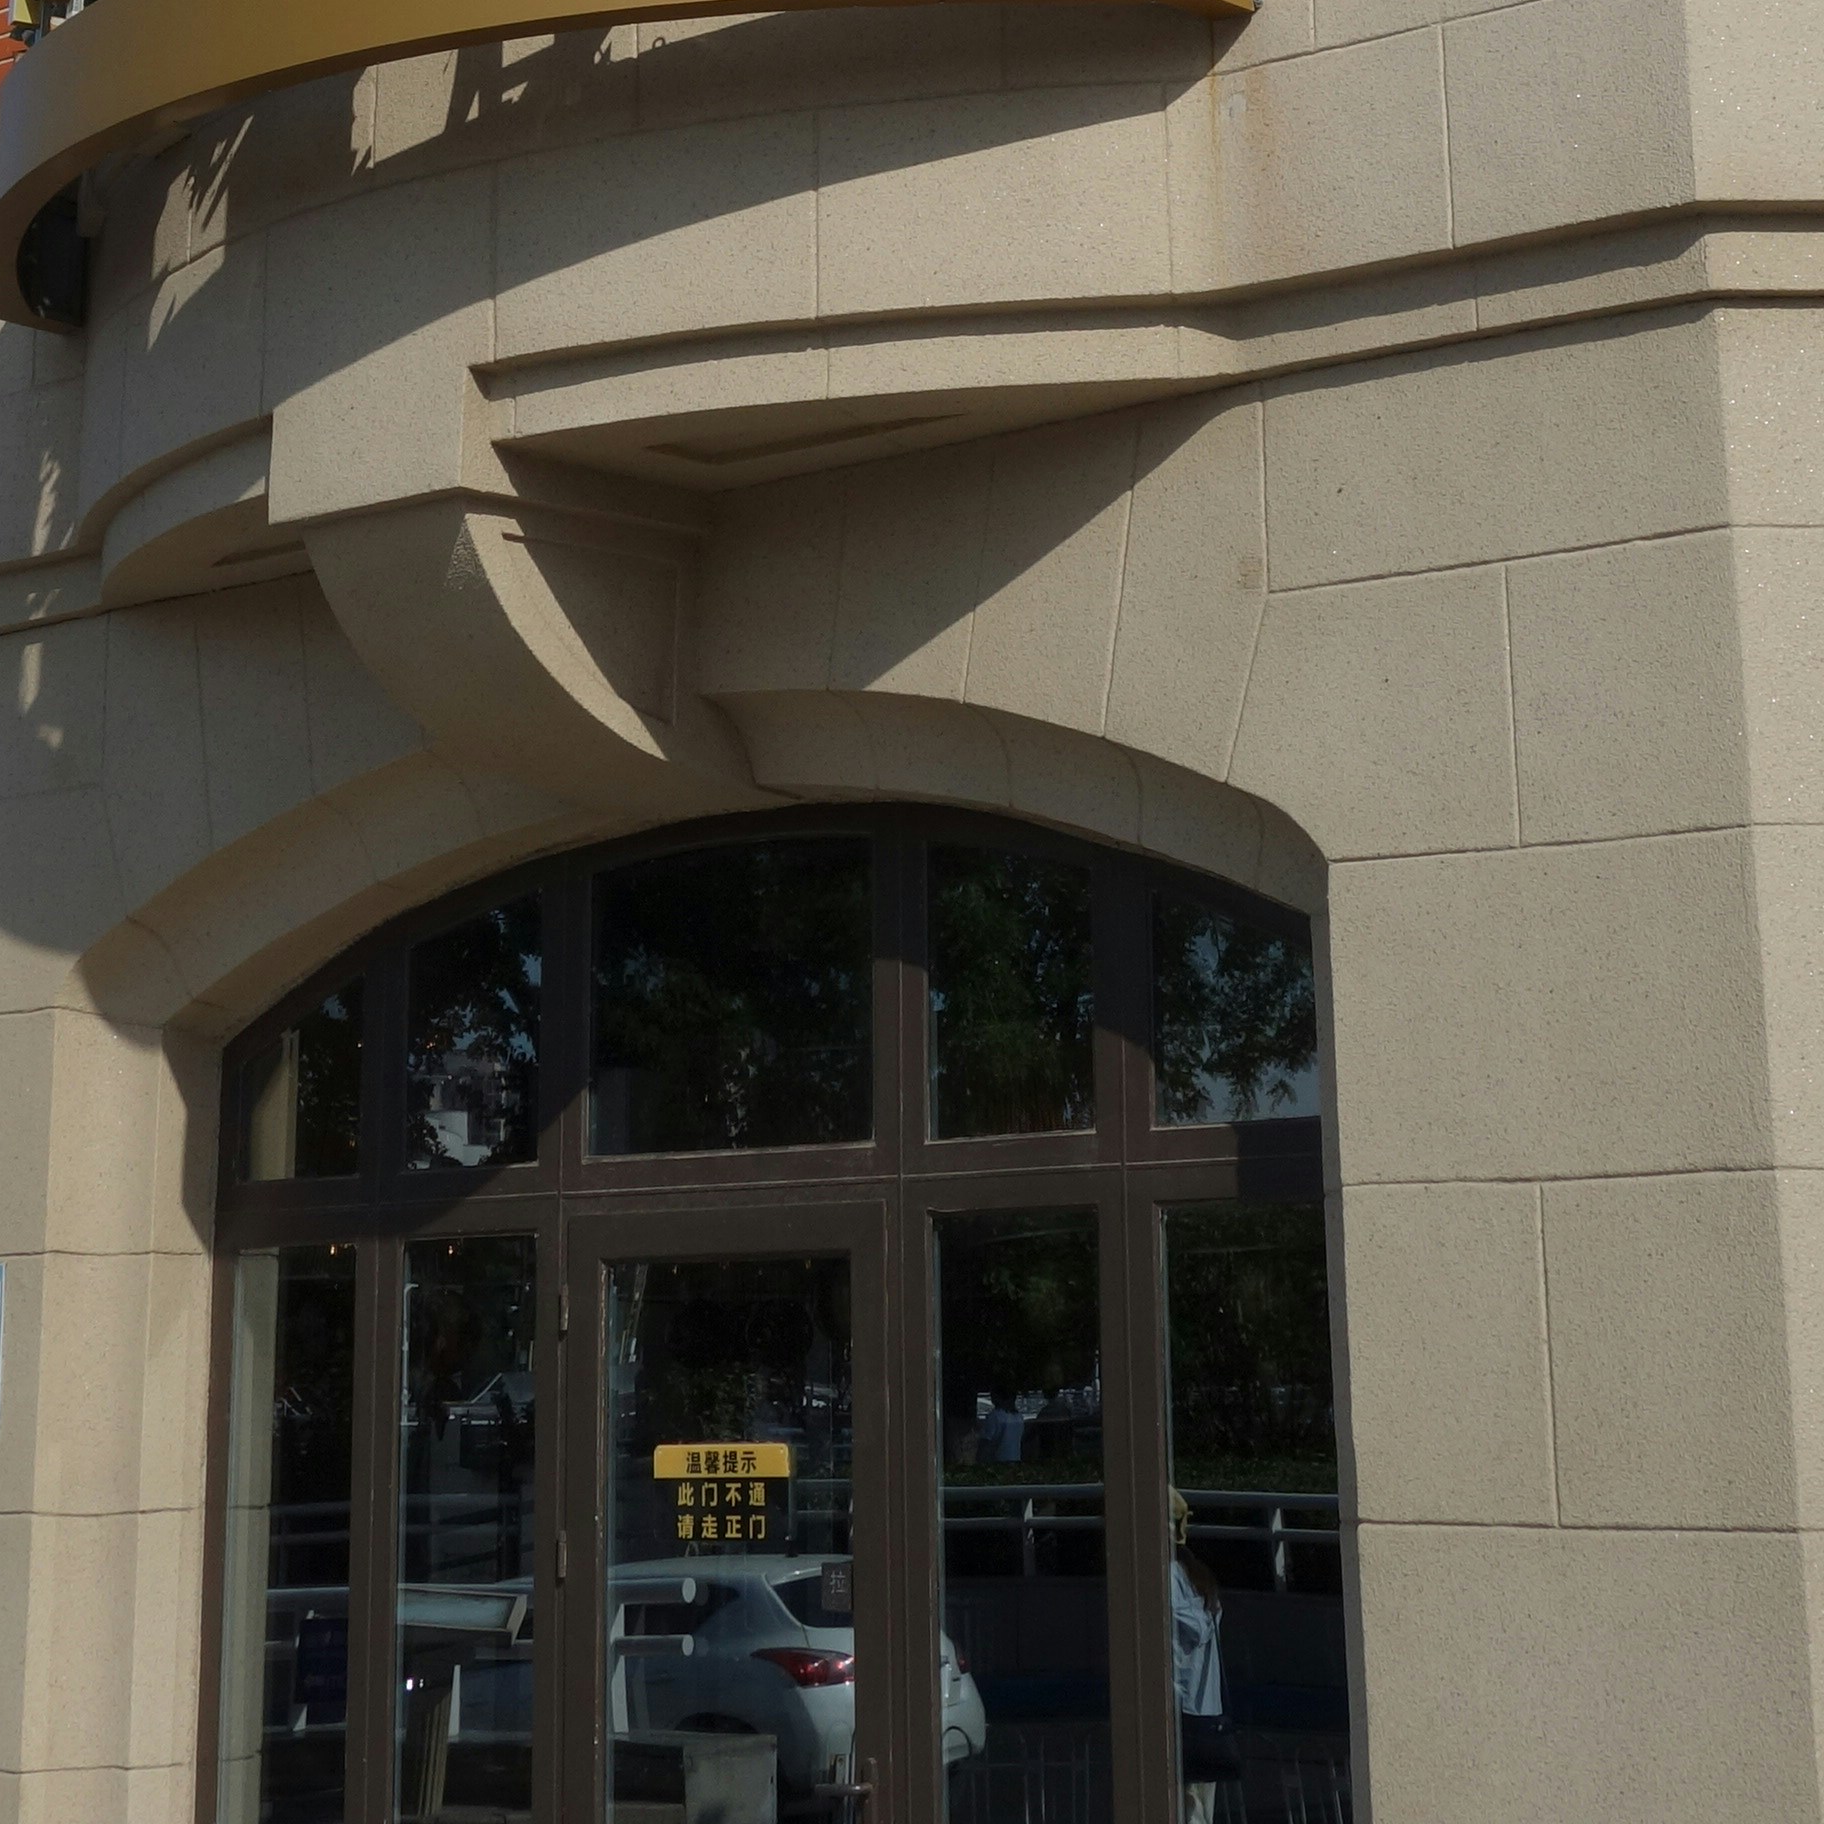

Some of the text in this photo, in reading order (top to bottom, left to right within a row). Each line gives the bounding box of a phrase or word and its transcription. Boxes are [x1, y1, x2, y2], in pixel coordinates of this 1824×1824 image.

[686, 1451, 757, 1474] 温馨提示
[677, 1482, 766, 1507] 此门不通
[677, 1514, 766, 1540] 请走正门
[829, 1570, 847, 1594] 拉
